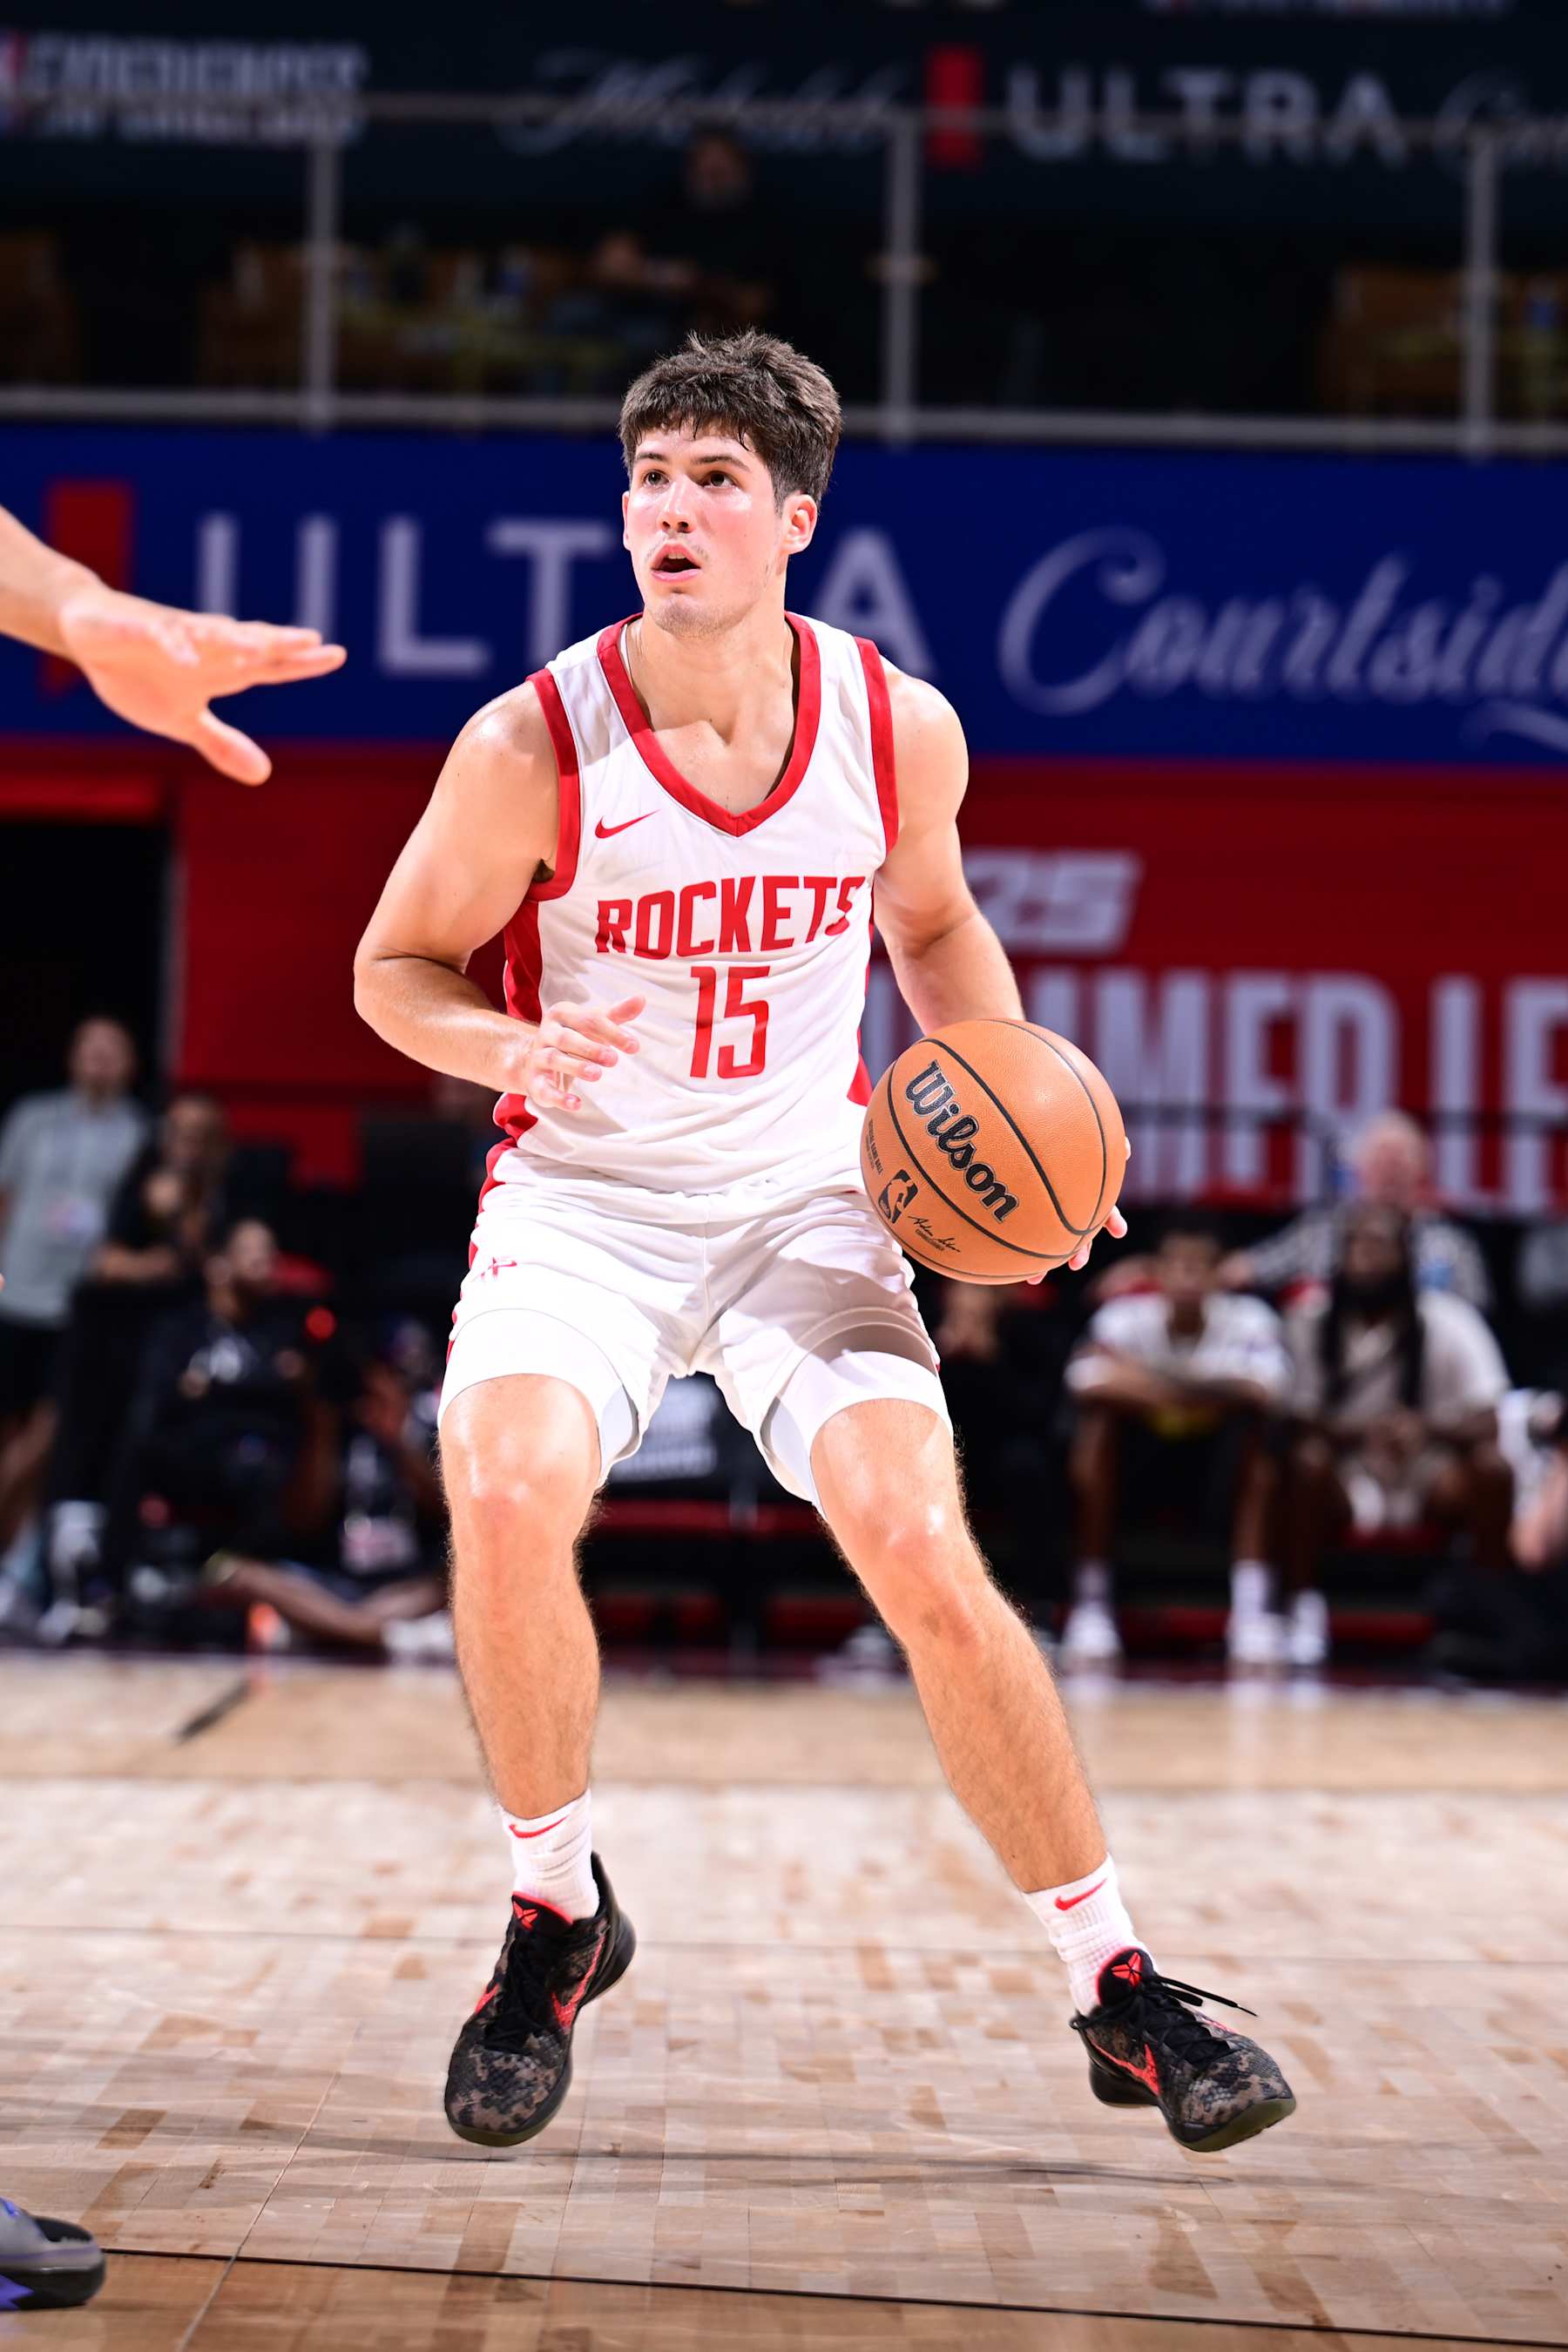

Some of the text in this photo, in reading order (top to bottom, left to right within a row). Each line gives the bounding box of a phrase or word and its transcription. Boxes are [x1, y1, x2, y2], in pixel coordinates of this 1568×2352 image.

[1004, 64, 1409, 166] ULTRA
[199, 514, 1568, 718] ULTA Courtsid
[595, 875, 866, 960] ROCKETS
[689, 965, 770, 1079] 15
[905, 1059, 1020, 1223] Wilson
